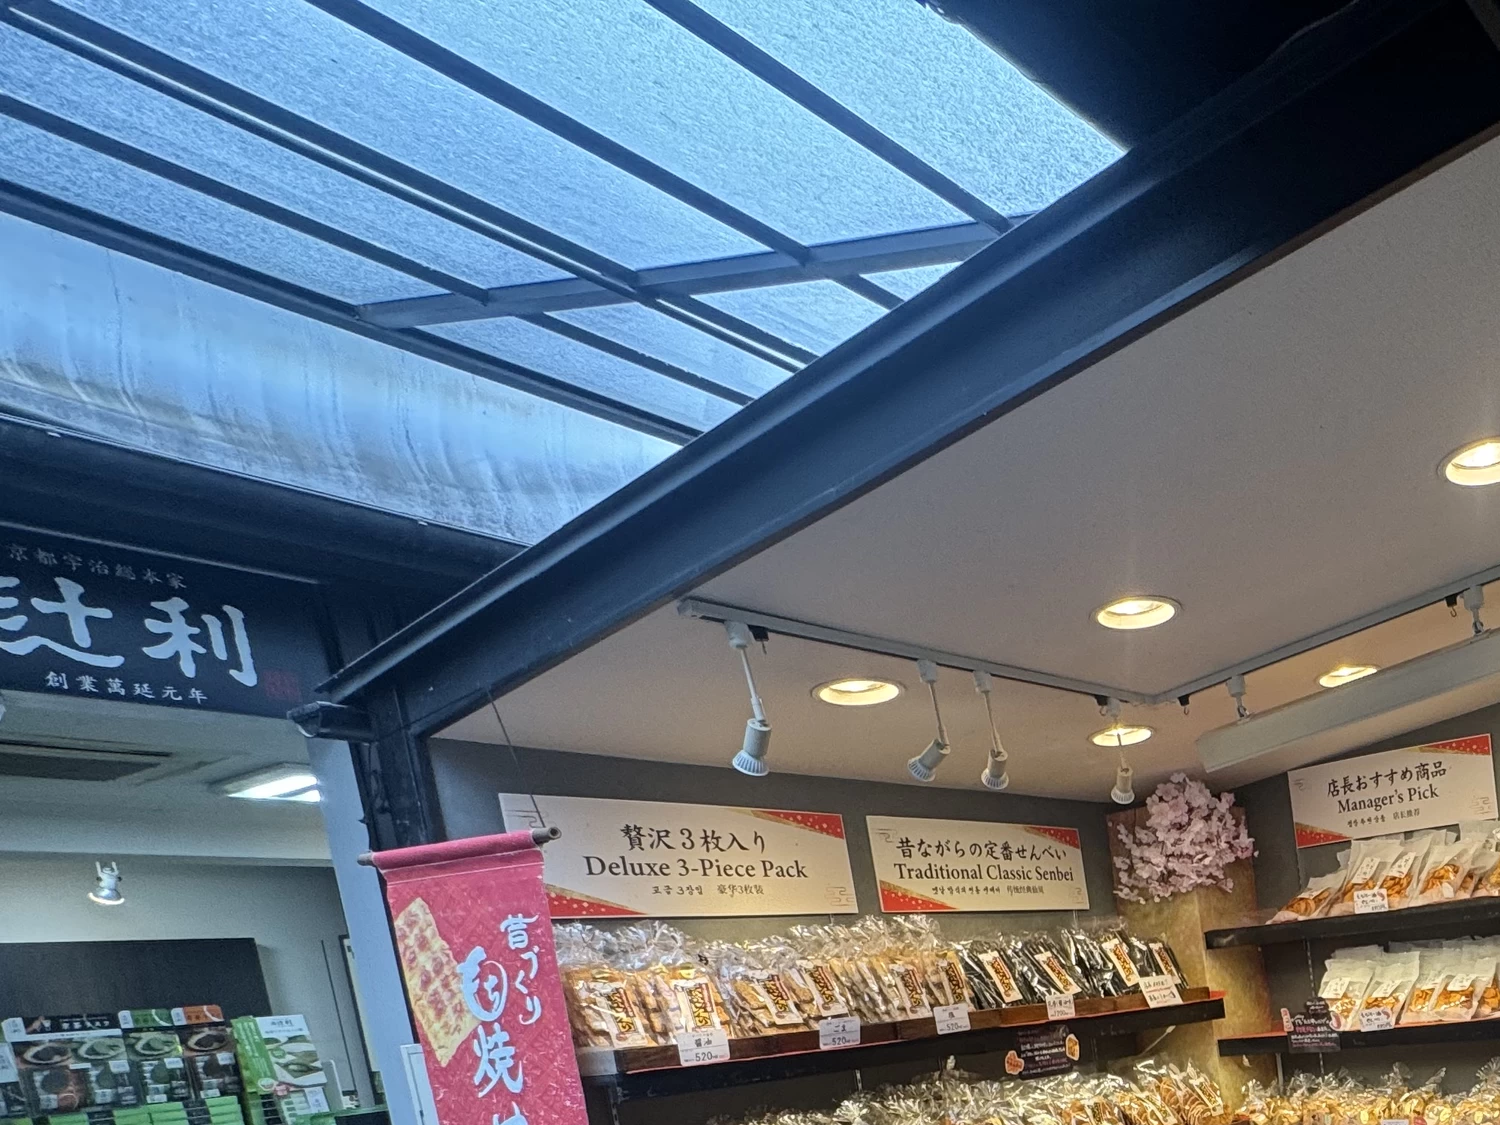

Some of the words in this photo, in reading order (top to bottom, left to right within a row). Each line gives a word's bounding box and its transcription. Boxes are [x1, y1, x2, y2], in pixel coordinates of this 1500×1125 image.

[45, 670, 208, 705] 創業萬延元年
[1327, 761, 1447, 797] 店長おすすめ商品
[1408, 783, 1439, 803] Pick
[895, 836, 1067, 862] 昔ながらの定番せんべい
[582, 854, 671, 877] Deluxe
[678, 857, 756, 878] 3-Piece
[762, 859, 808, 879] Pack
[894, 862, 983, 881] Traditional
[986, 864, 1032, 881] Classic
[1035, 866, 1074, 882] Senbei
[499, 914, 542, 1025] 昔づくり
